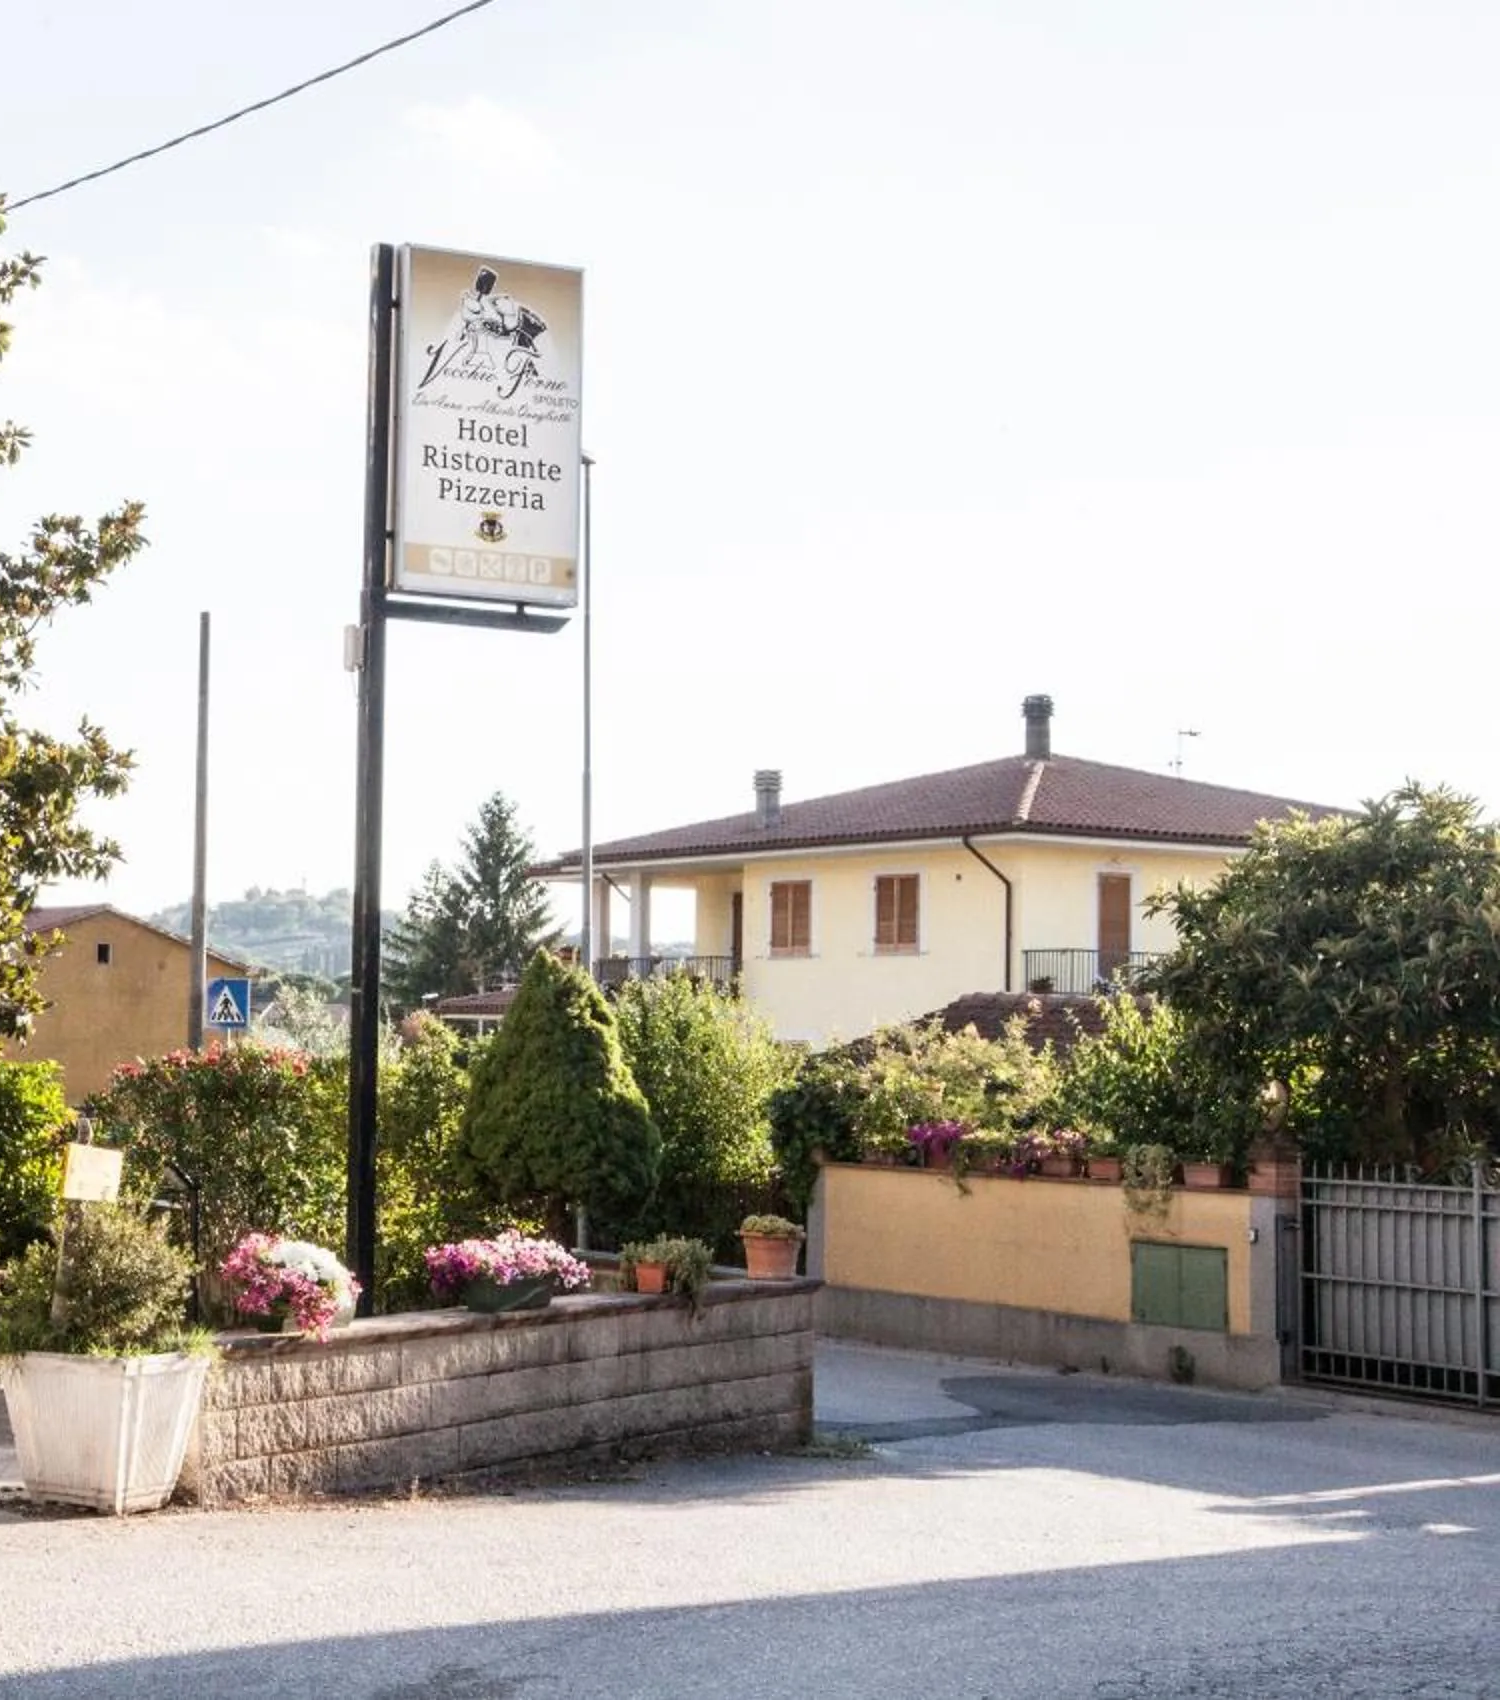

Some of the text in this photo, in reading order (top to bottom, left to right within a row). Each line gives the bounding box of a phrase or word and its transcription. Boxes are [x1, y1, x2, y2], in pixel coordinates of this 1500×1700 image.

[458, 417, 529, 448] Hotel
[422, 444, 562, 482] Ristorante
[439, 477, 546, 511] Pizzeria
